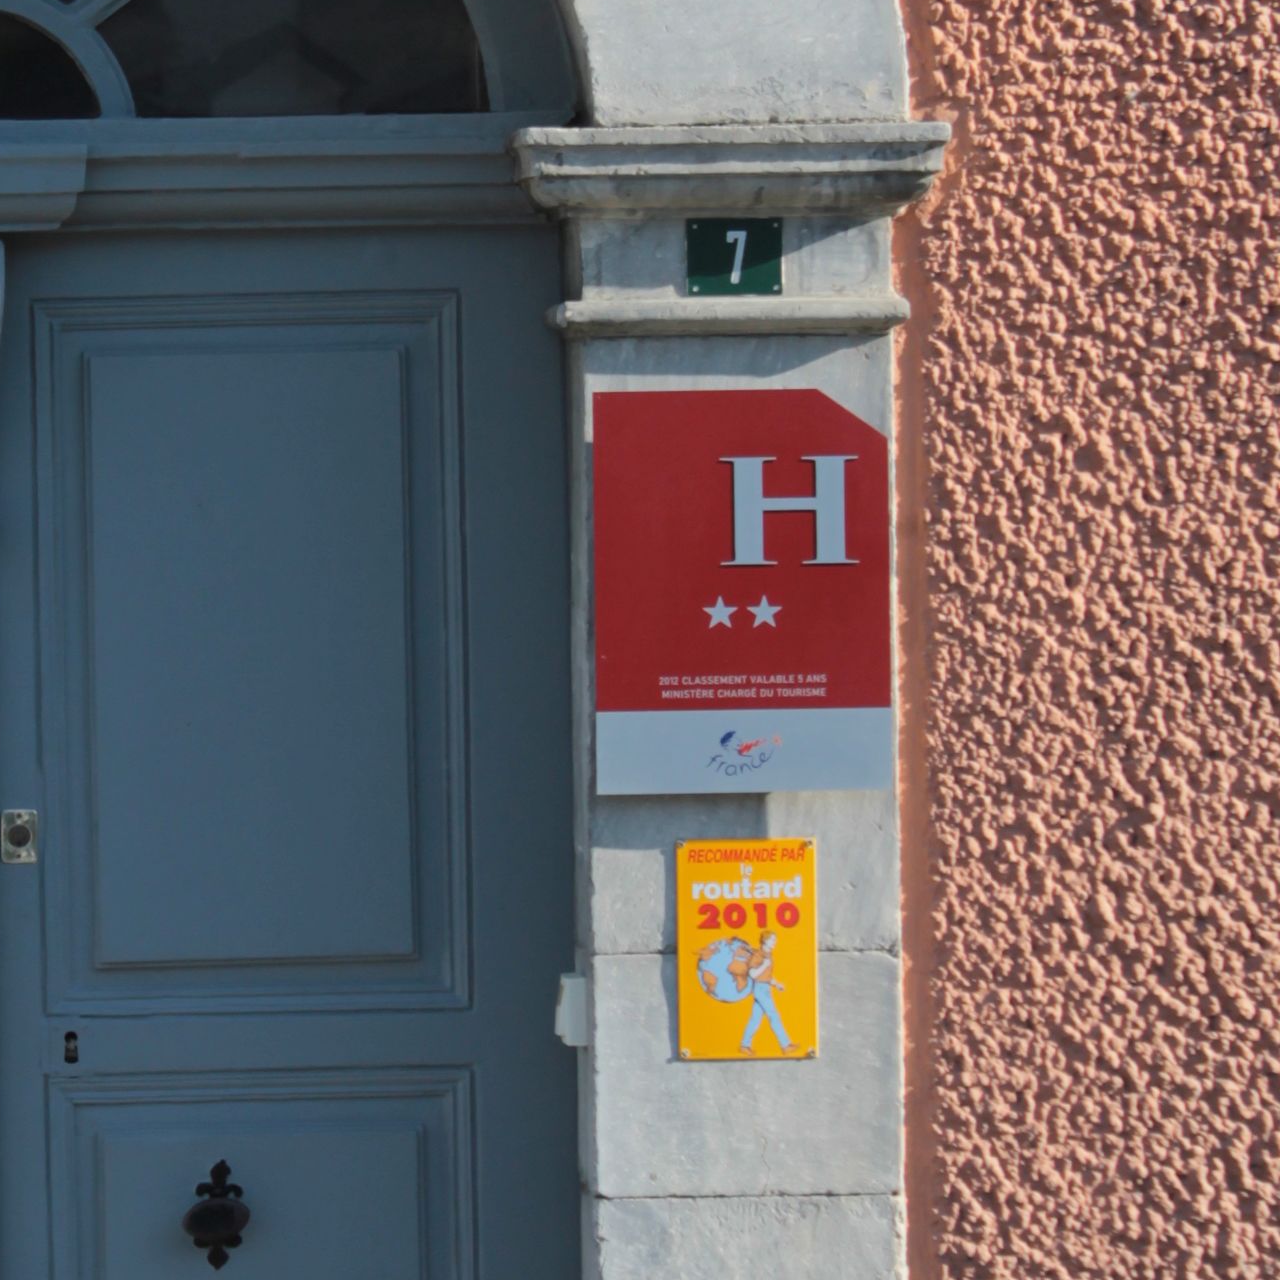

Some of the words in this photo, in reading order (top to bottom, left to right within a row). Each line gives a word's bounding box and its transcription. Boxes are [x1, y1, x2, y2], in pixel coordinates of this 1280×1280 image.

[726, 229, 748, 285] 7
[719, 455, 861, 567] H
[659, 676, 679, 686] 2012
[682, 675, 748, 686] CLASSEMENT
[750, 674, 794, 685] VALABLE
[797, 674, 804, 684] 5
[806, 674, 828, 684] ANS
[661, 687, 714, 699] MINISTÈRE
[717, 686, 757, 699] CHARGÉ
[760, 687, 774, 698] DU
[777, 687, 827, 698] TOURISME
[687, 845, 777, 864] RECOMMANDÉ
[780, 846, 806, 862] PAR
[739, 862, 754, 875] le
[691, 872, 803, 900] routard
[697, 902, 801, 930] 2010
